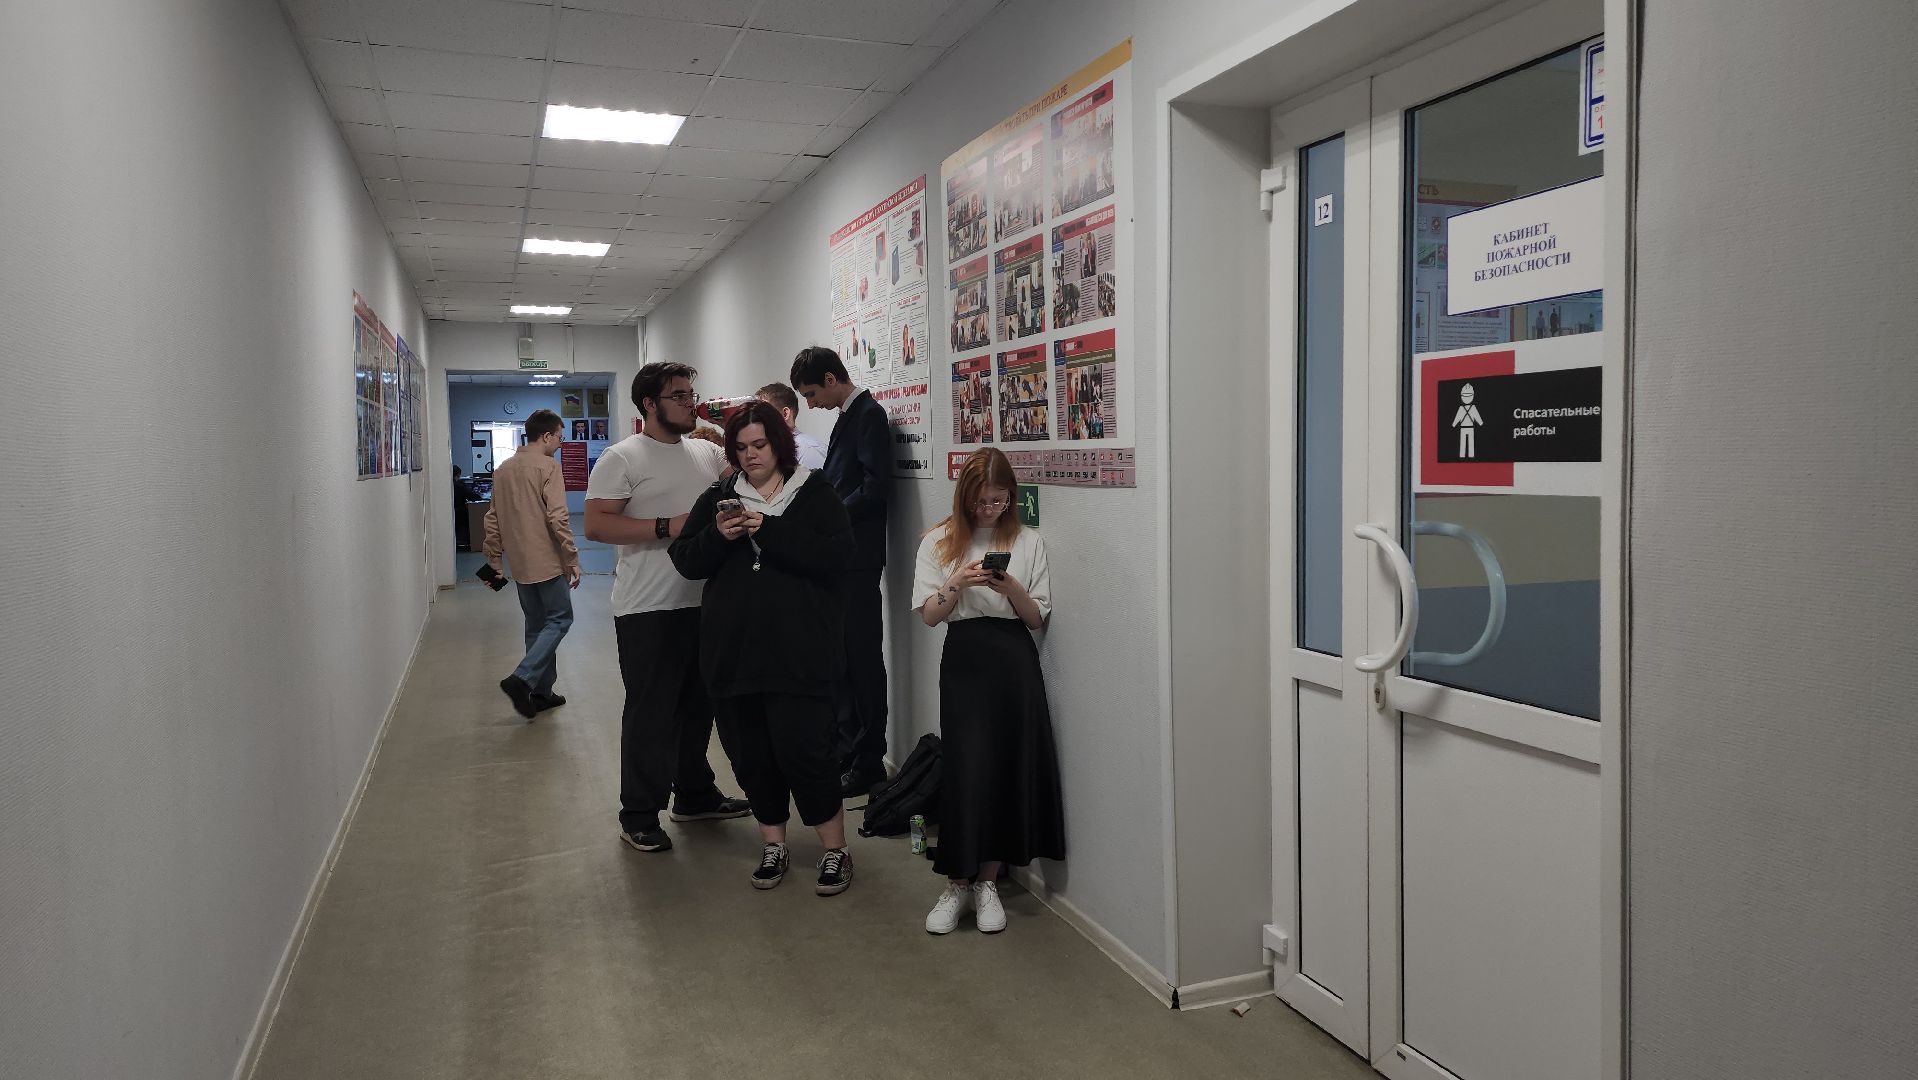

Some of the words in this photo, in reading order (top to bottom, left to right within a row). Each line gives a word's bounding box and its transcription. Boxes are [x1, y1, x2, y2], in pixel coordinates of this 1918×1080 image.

[1041, 83, 1068, 111] ПОЖАРЕ
[1318, 202, 1329, 220] 12
[1493, 222, 1549, 246] КАБИНЕТ
[1486, 234, 1557, 263] ПОЖАРНОЙ
[1474, 251, 1571, 282] БЕЗОПАСНОСТИ
[1513, 406, 1601, 419] Спасательные
[1513, 424, 1556, 439] работы
